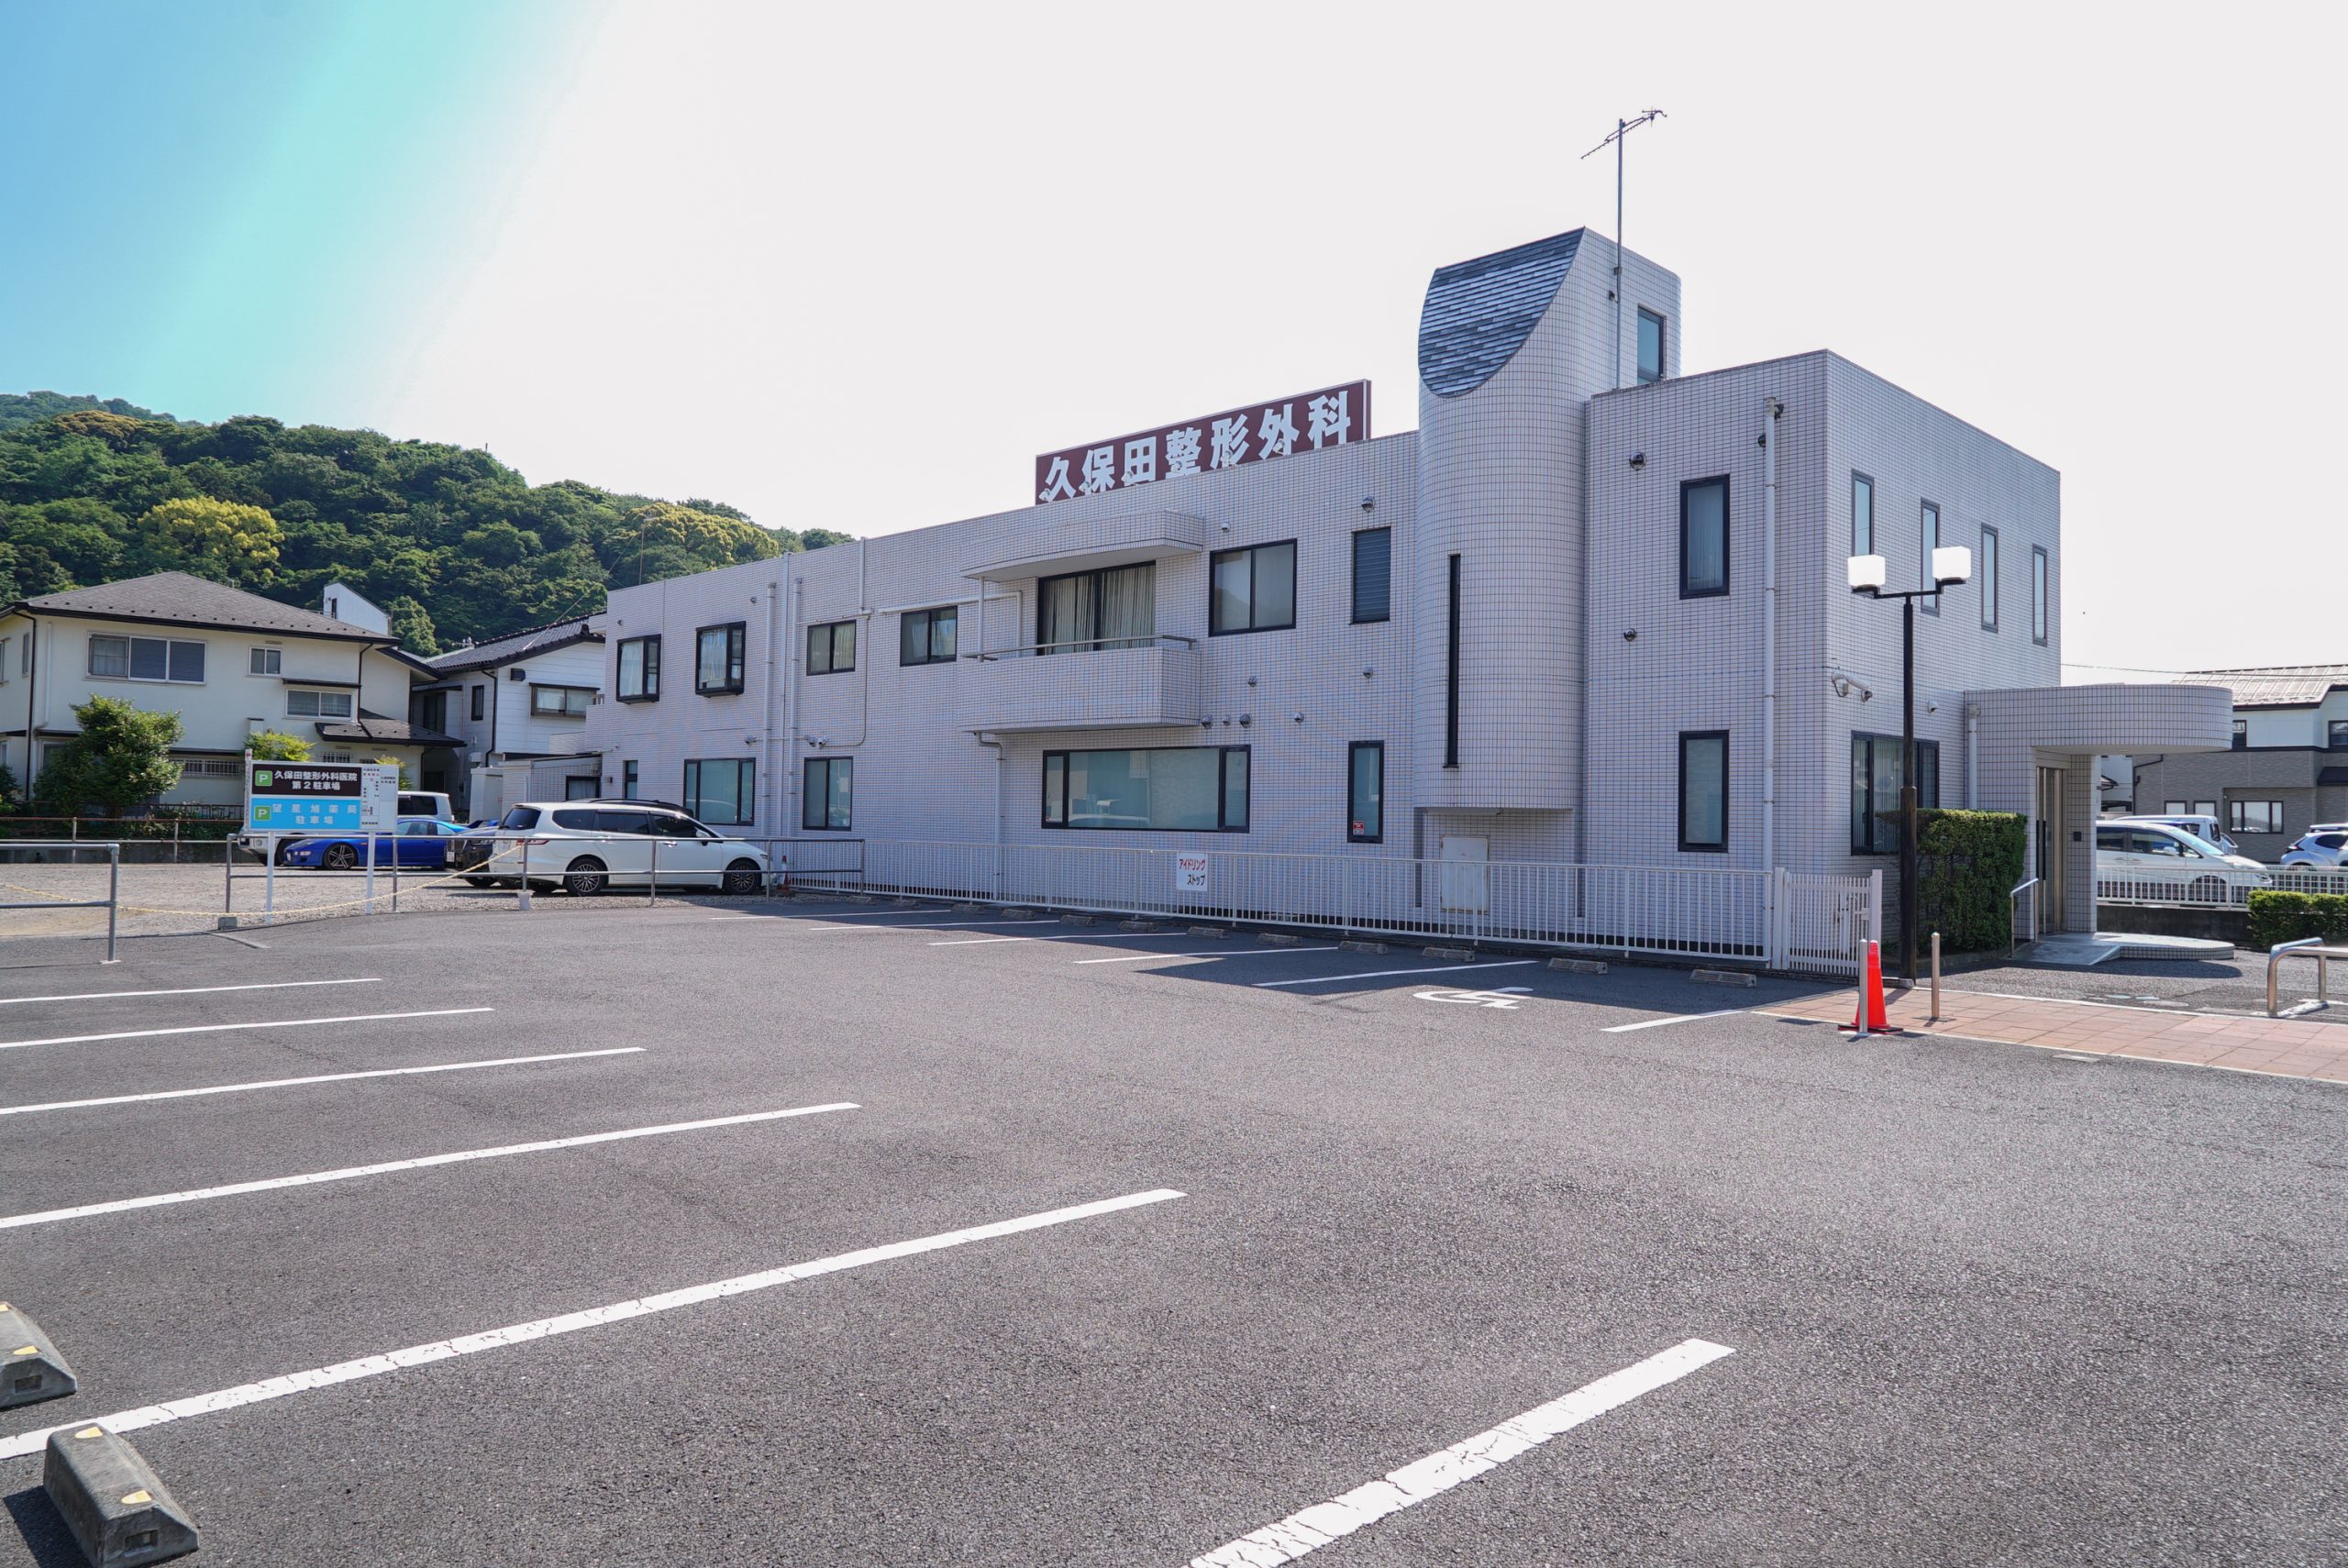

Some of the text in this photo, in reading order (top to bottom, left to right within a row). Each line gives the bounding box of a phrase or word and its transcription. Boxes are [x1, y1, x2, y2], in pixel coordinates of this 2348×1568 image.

[1044, 390, 1351, 502] 久保田整形外科
[260, 774, 268, 783] P
[274, 770, 358, 781] 久保田整形外科医院
[259, 810, 267, 818] P
[1180, 858, 1205, 871] アイドリング
[1187, 873, 1205, 886] ストップ
